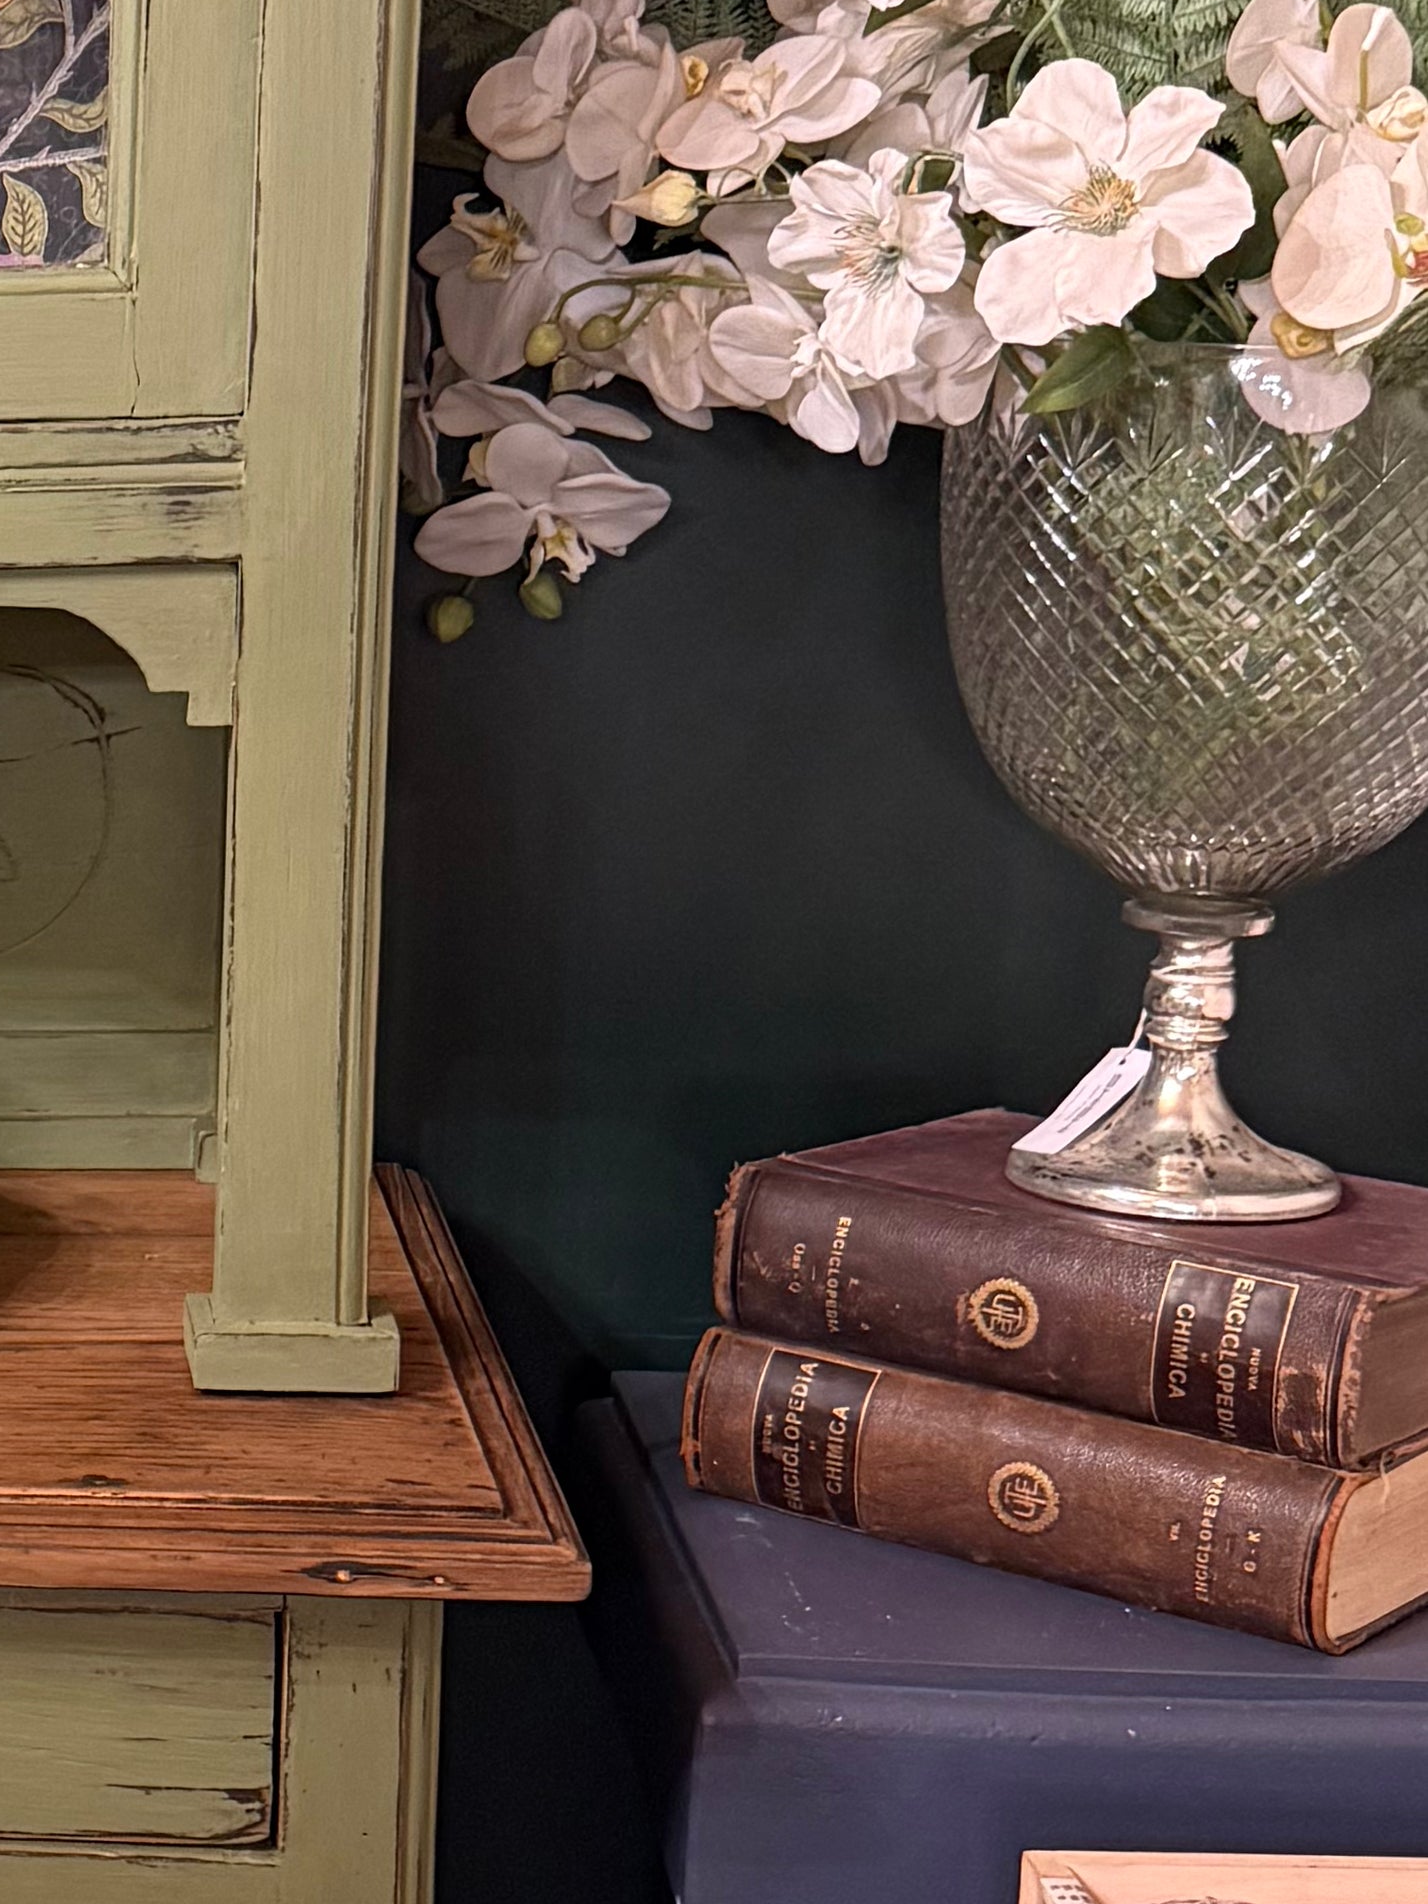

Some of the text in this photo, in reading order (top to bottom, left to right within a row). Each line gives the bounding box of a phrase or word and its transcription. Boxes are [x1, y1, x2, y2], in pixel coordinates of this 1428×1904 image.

[825, 1216, 852, 1334] ENCICLOPEDIA
[1167, 1303, 1196, 1399] CHIMICA
[1215, 1277, 1256, 1439] ENCICLOPEDIA
[782, 1362, 820, 1512] ENCICLOPEDIA
[824, 1406, 851, 1495] CHIMICA
[1194, 1475, 1227, 1603] ENCICLOPEDIA
